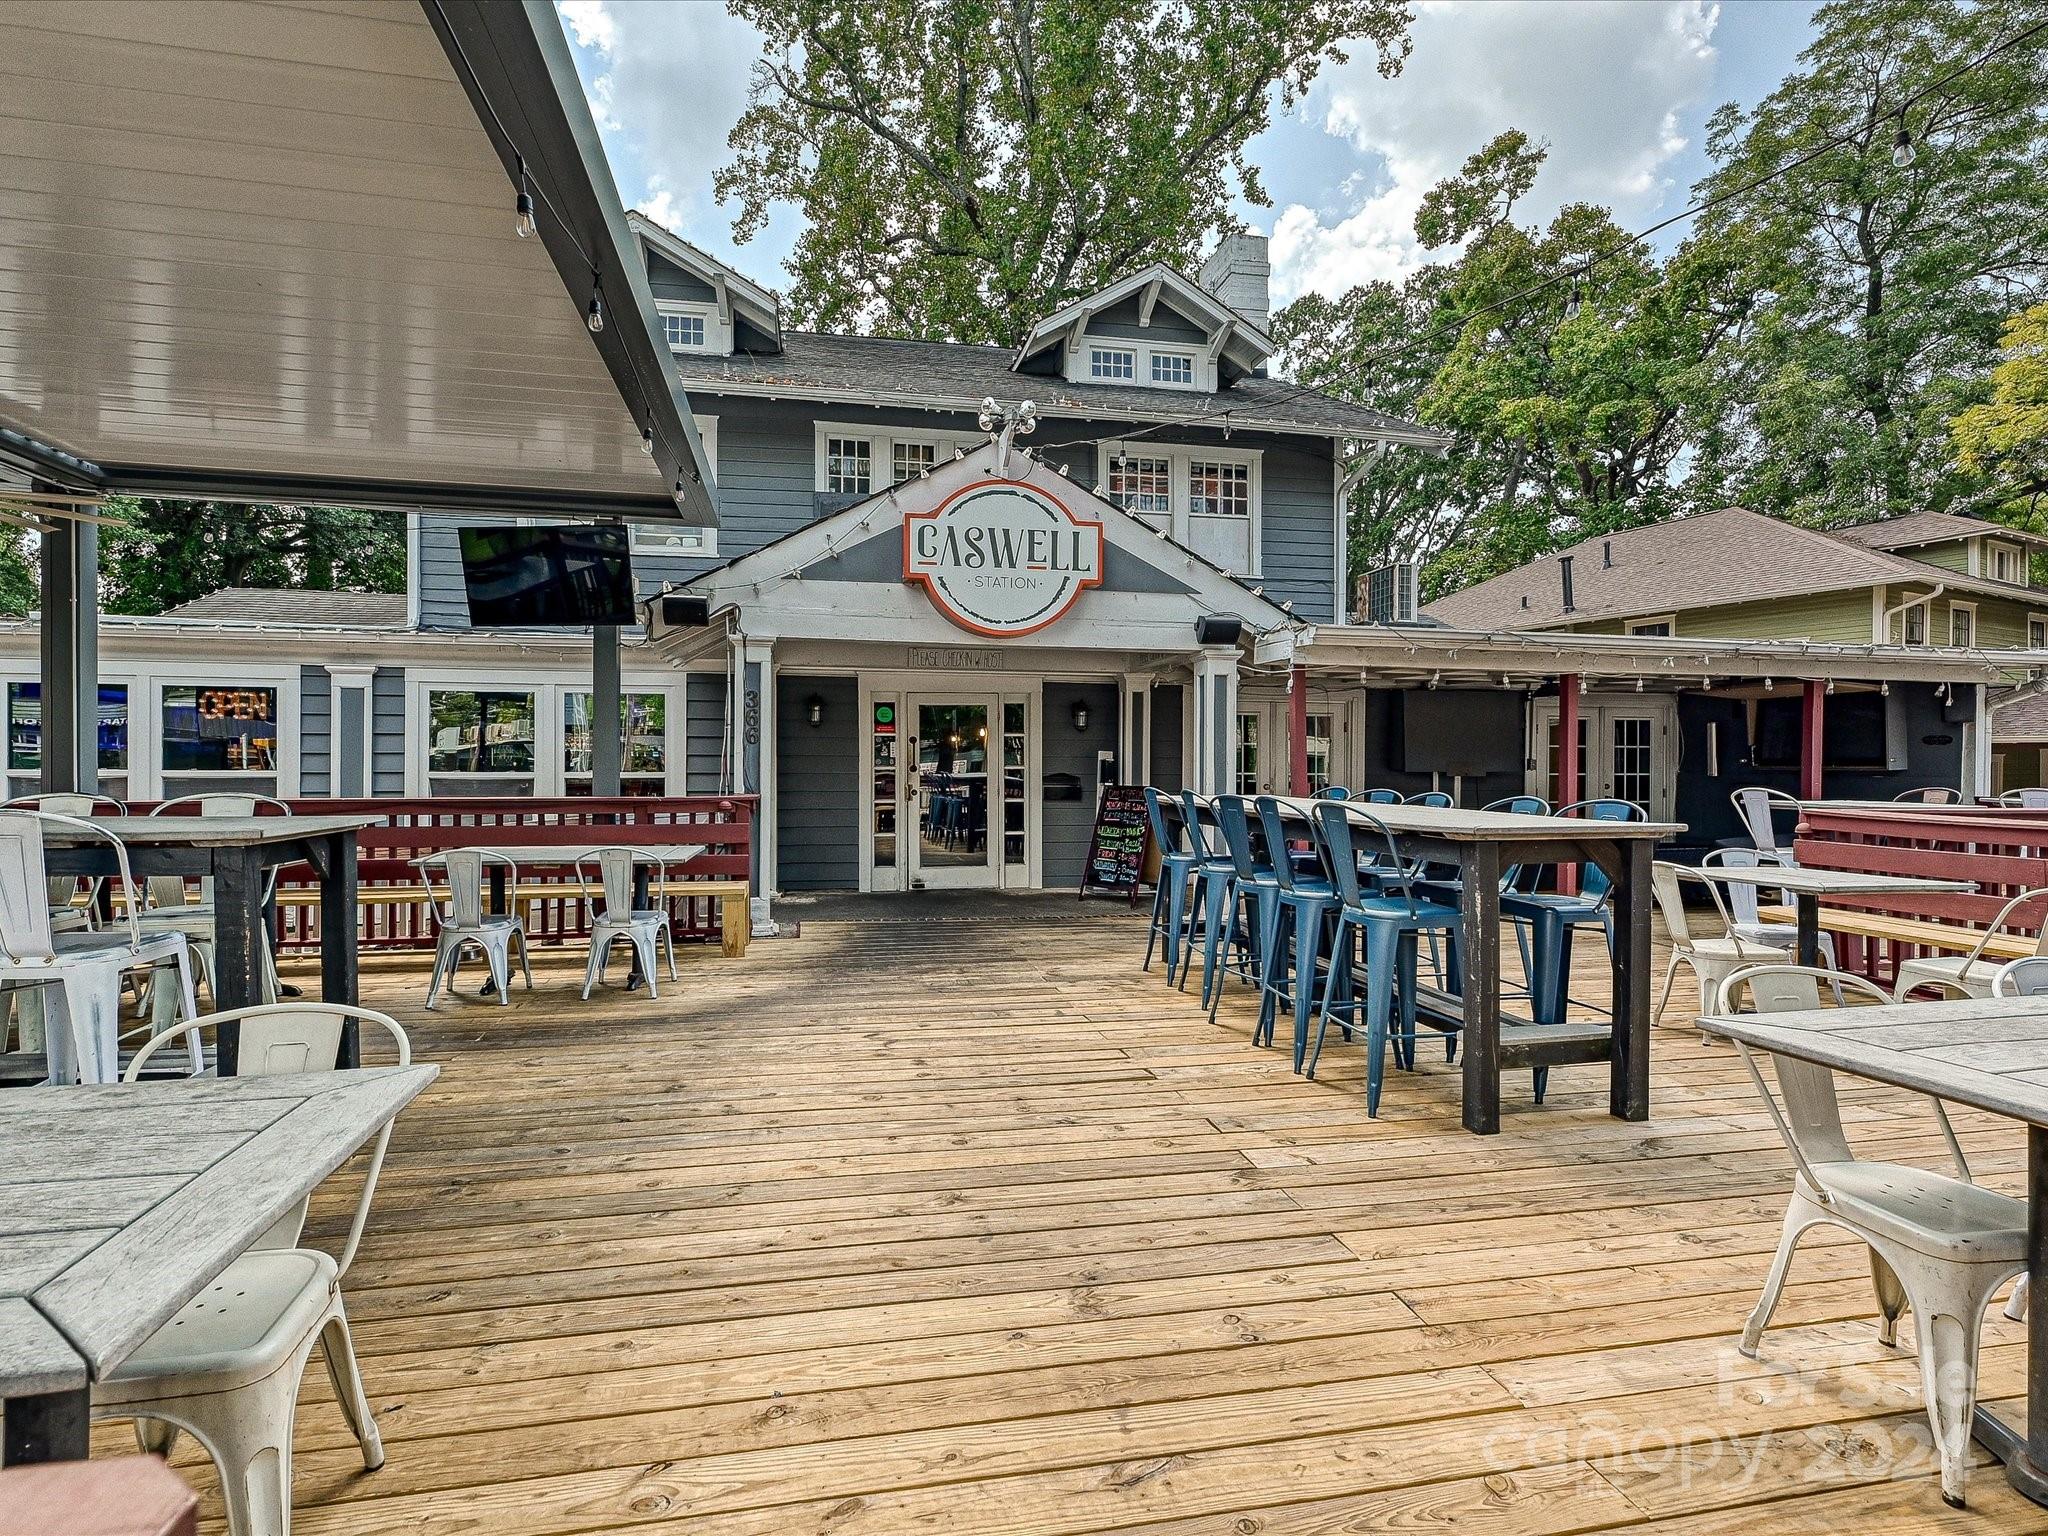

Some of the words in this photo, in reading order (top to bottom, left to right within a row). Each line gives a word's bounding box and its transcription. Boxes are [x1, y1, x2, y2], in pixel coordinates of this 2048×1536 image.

[917, 524, 1091, 572] CASWELL
[974, 575, 1037, 589] STATION
[913, 648, 938, 667] PLEASE
[199, 691, 267, 720] OPEN
[745, 690, 759, 745] 366
